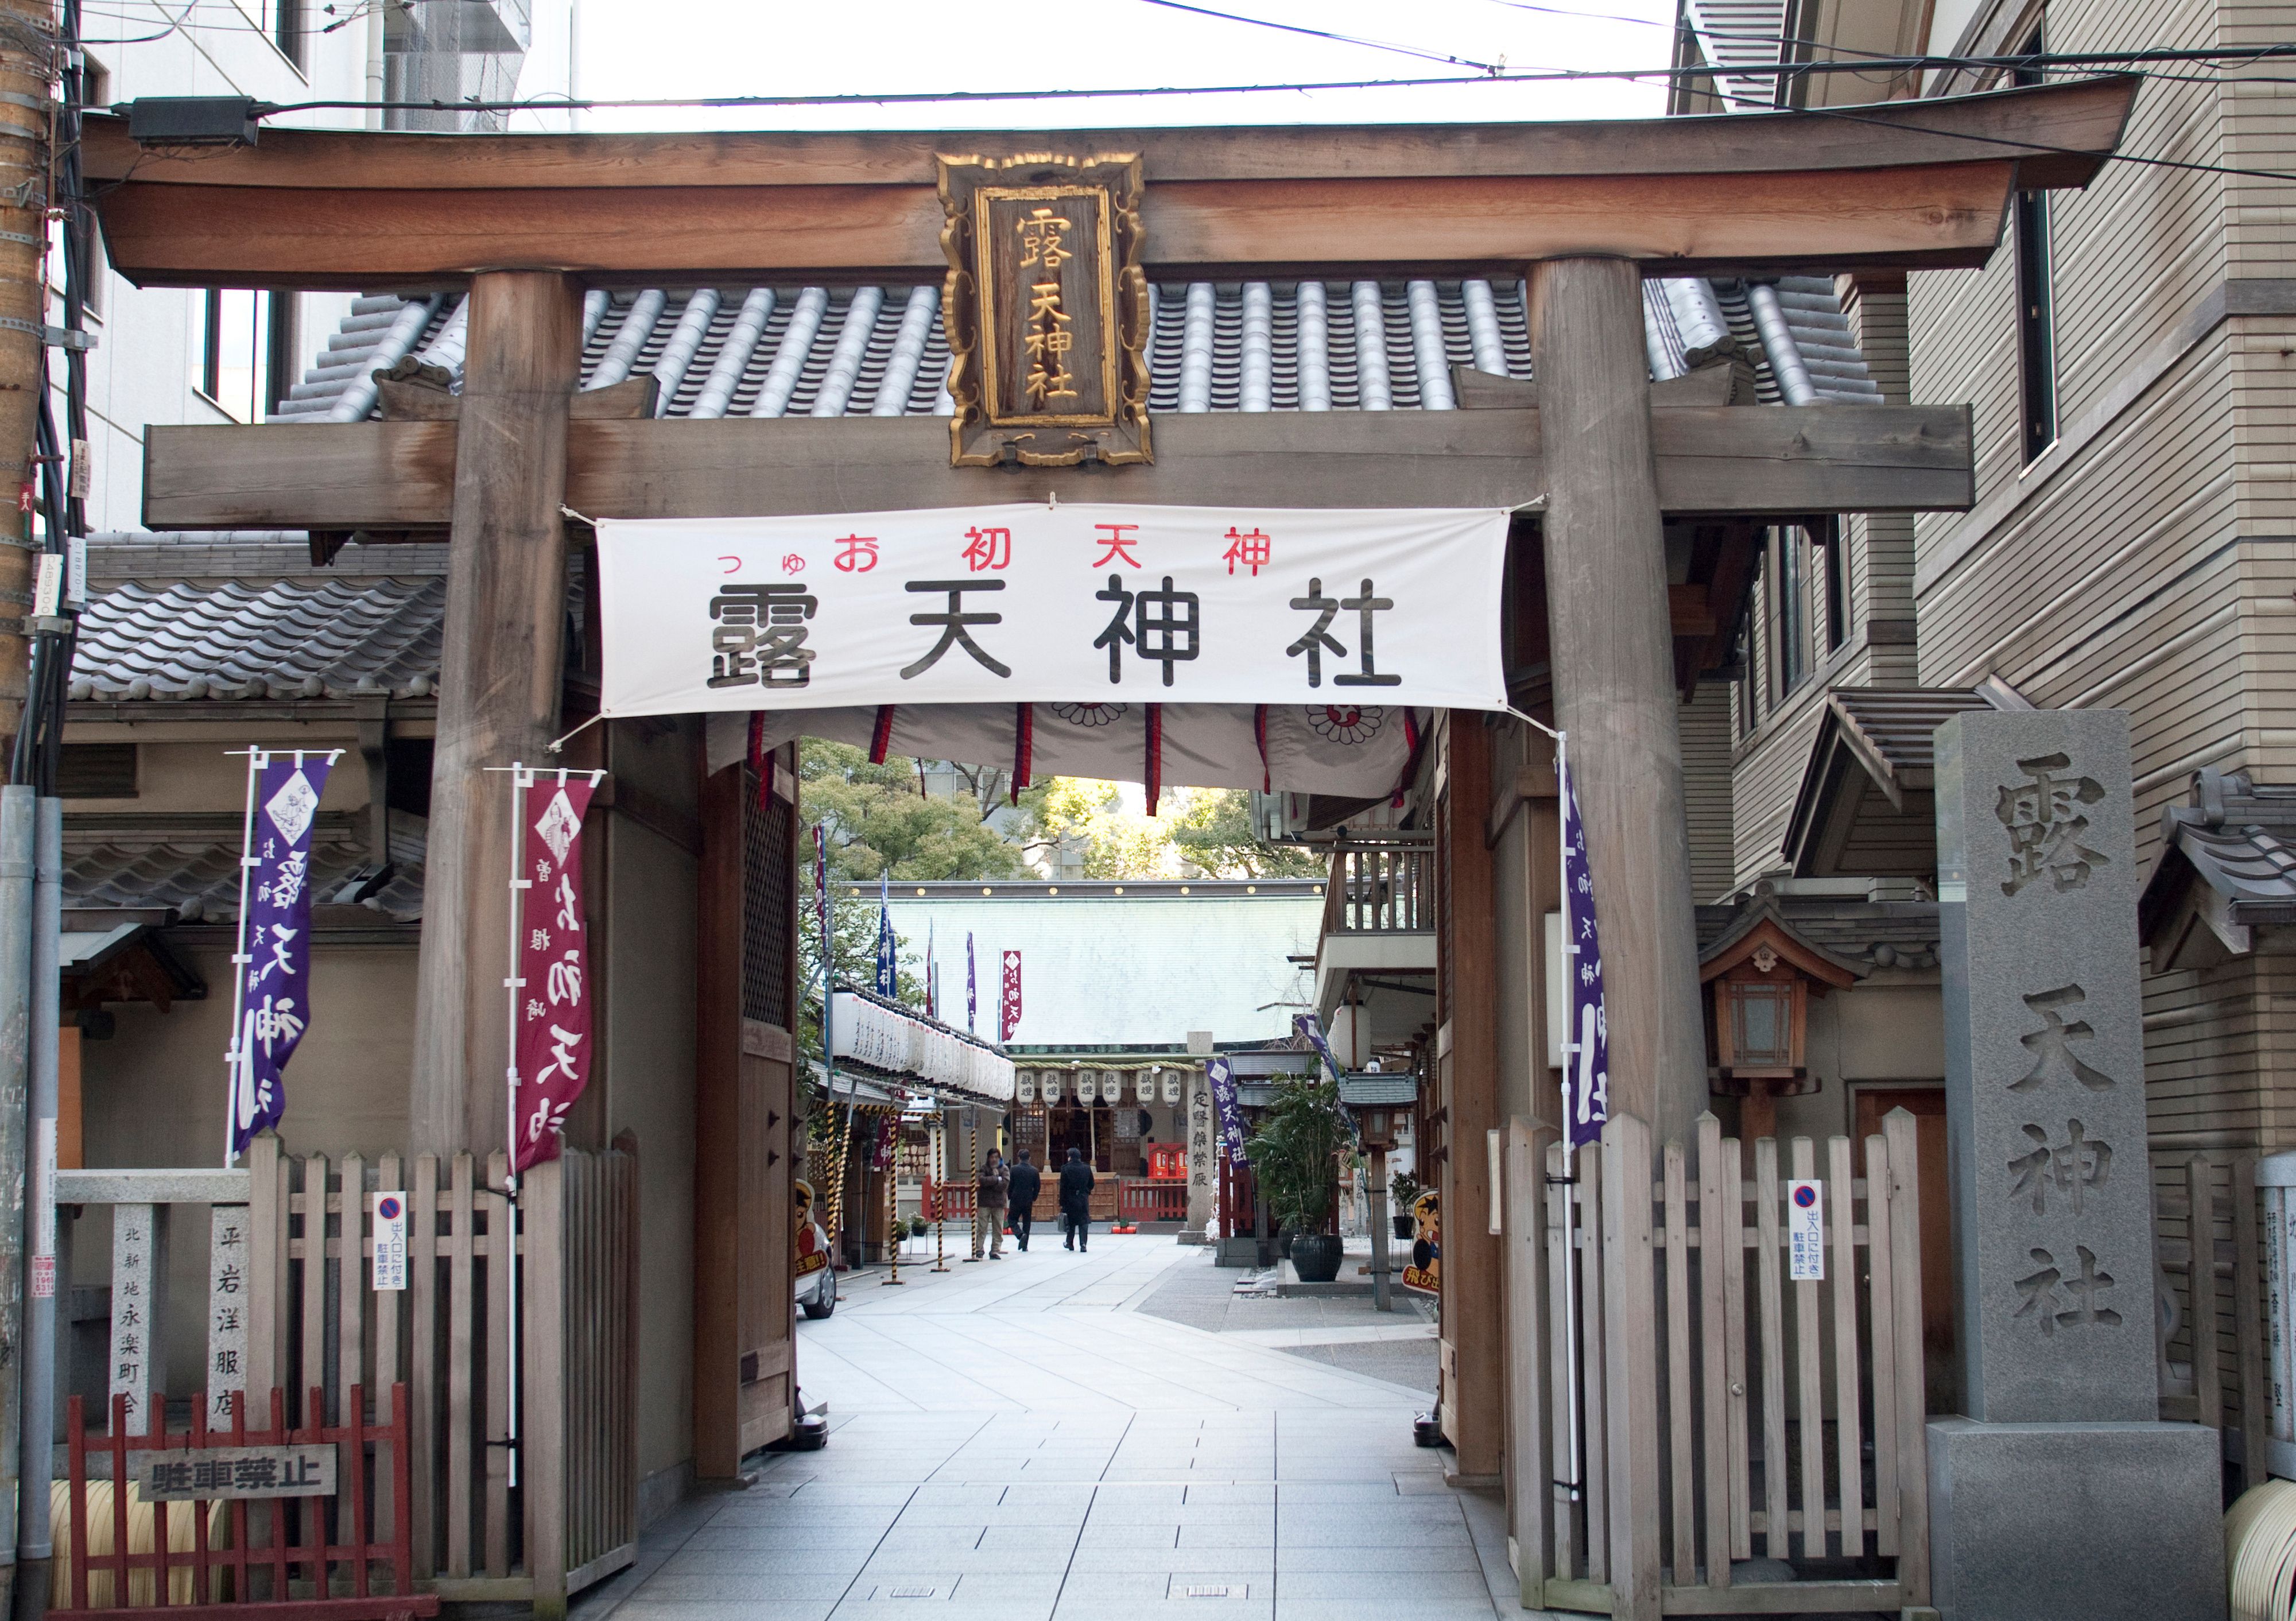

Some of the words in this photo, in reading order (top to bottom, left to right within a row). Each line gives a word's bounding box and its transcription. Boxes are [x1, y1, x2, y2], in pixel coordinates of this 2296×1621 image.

[1017, 208, 1077, 400] 露天神社
[718, 553, 805, 576] つゆ
[833, 523, 1271, 577] お初天神
[707, 572, 1402, 691] 露天神社
[1994, 751, 2123, 1339] 露天神社
[377, 1243, 389, 1285] 駐車禁止
[391, 1221, 403, 1285] 出入口に付き
[1792, 1231, 1805, 1275] 駐車禁止
[1806, 1210, 1820, 1275] 出入口に付き
[214, 1227, 241, 1416] 平岩洋服店
[151, 1455, 322, 1494] 駐車禁止
